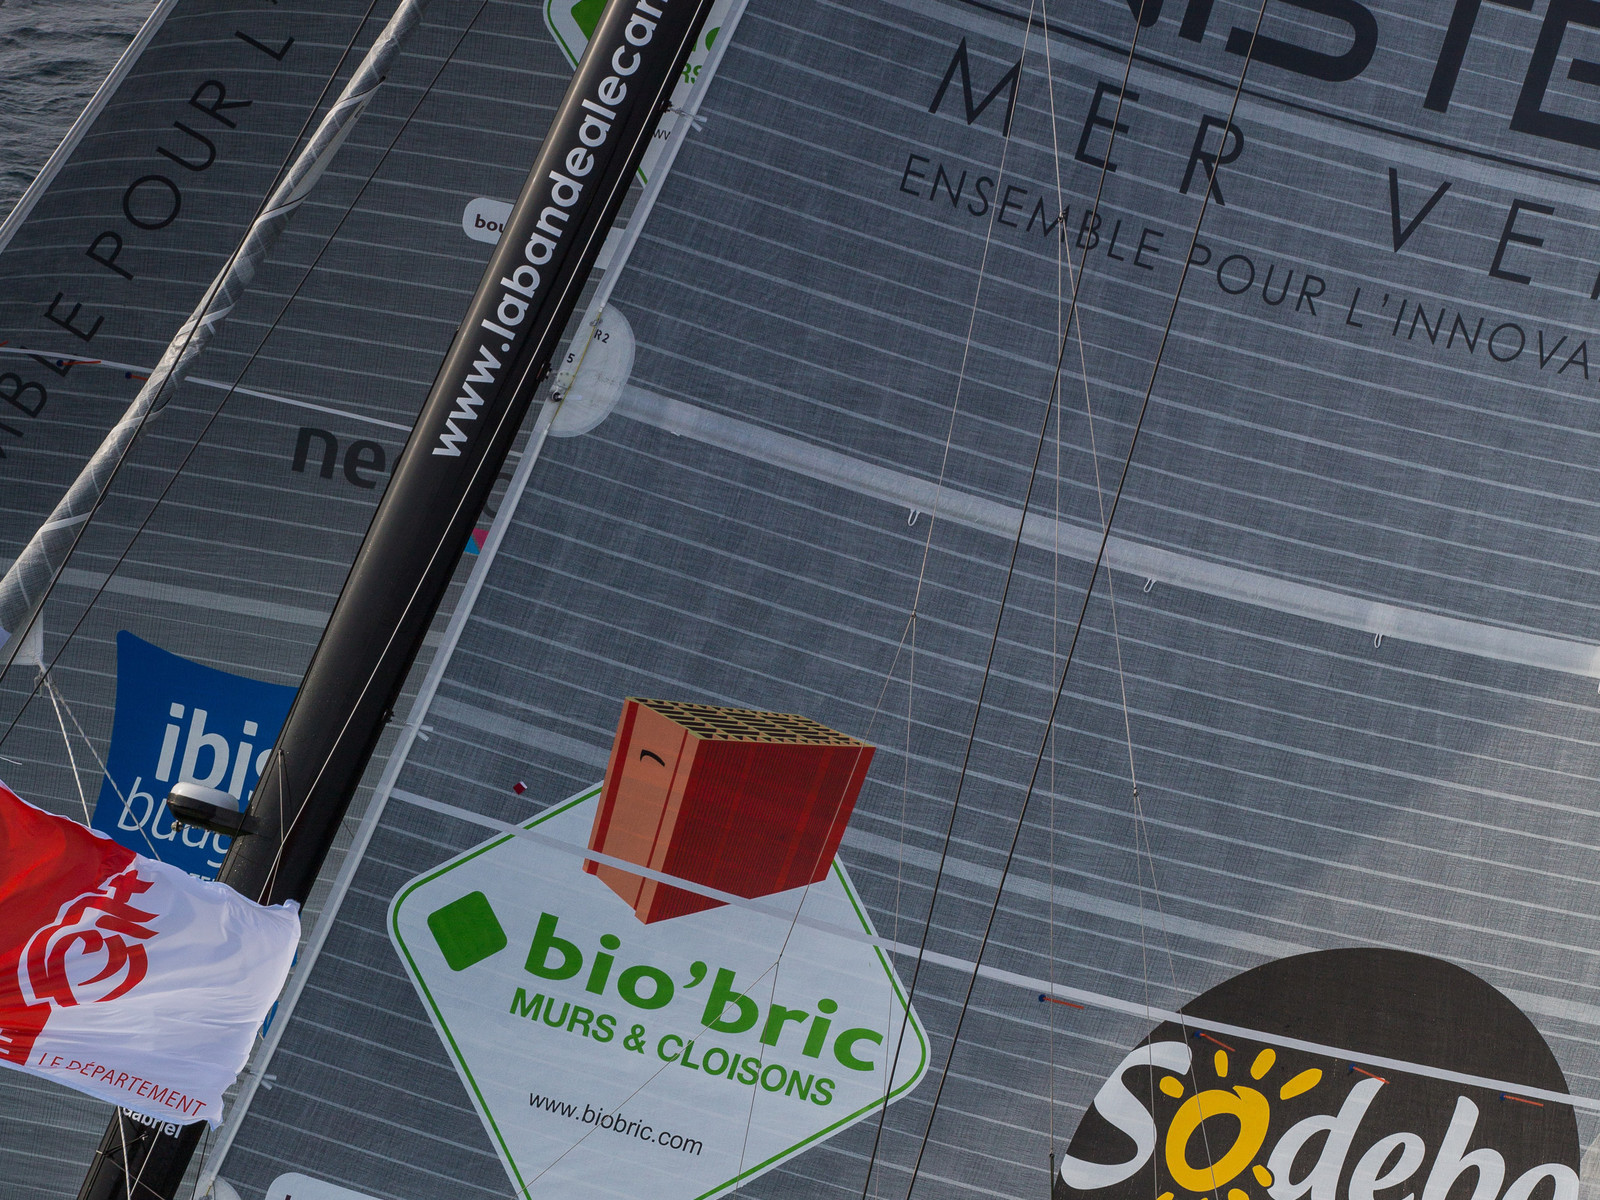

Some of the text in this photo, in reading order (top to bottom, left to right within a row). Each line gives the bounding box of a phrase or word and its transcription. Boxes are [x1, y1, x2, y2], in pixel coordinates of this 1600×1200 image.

[85, 0, 295, 281] POUR L
[927, 36, 1600, 301] MER VE
[900, 153, 1600, 382] ENSEMBLE POUR L'INNOVA
[0, 292, 105, 458] BLE
[566, 353, 575, 364] 5
[509, 987, 836, 1107] MURS & CLOISONS
[523, 911, 885, 1072] bio'bric
[65, 1060, 207, 1117] DÉPARTEMENT
[528, 1092, 703, 1156] www.biobric.com
